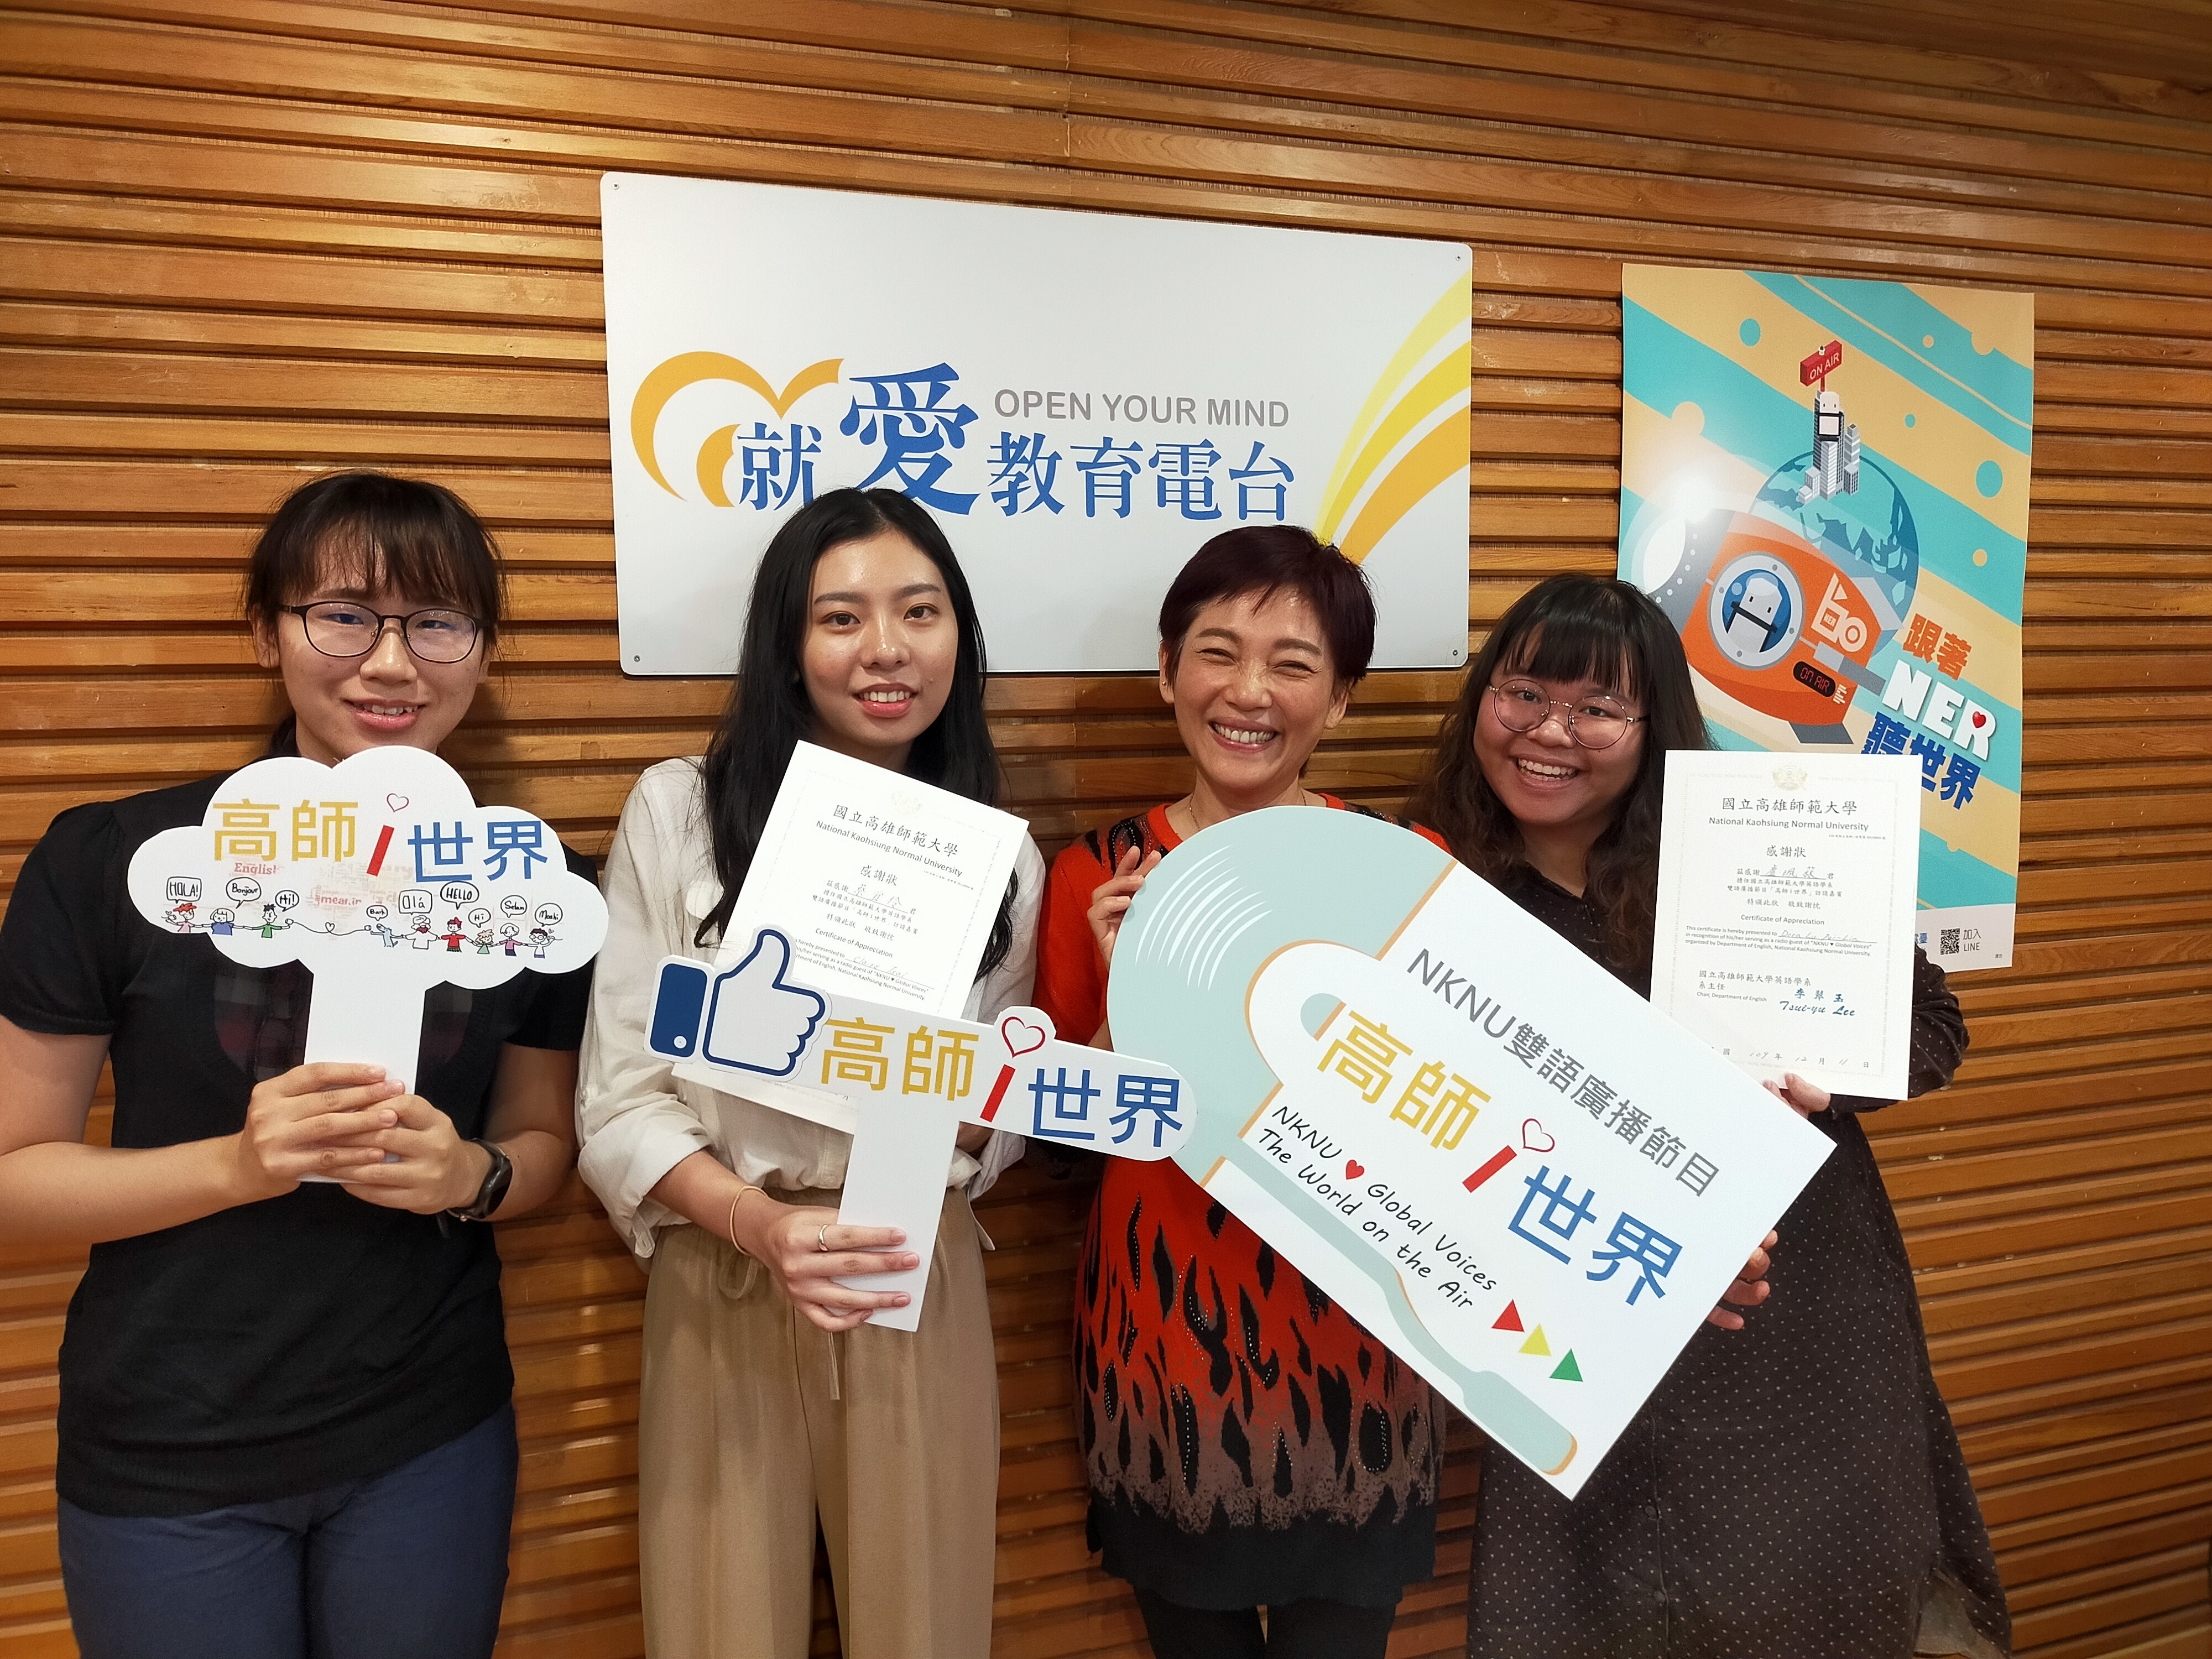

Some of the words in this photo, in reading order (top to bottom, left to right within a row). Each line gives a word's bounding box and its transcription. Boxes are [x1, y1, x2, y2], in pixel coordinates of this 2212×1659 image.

[1809, 358, 1823, 381] ON
[1825, 351, 1840, 371] AIR
[994, 388, 1091, 422] OPEN
[1103, 393, 1198, 425] YOUR
[1208, 398, 1290, 428] MIND
[738, 362, 1296, 521] 就愛教育電台
[1902, 613, 1973, 681] 跟著
[1814, 676, 1830, 693] AIR
[1881, 659, 1997, 761] NER
[1722, 797, 1858, 816] 國立高雄師範大學
[833, 805, 958, 857] 國立高雄師範大學
[1709, 817, 1744, 826] National
[1746, 818, 1790, 829] Kaohsiung
[1791, 820, 1823, 829] Normal
[1825, 821, 1869, 832] University
[816, 820, 851, 837] National
[851, 831, 891, 853] Kaohsiung
[892, 846, 922, 862] Normal
[924, 857, 963, 878] University
[1766, 844, 1807, 858] 感謝狀
[860, 865, 898, 886] 感謝狀
[169, 881, 199, 898] HOLA!
[231, 883, 259, 896] Bonjour
[446, 887, 473, 901] HELLO
[279, 894, 295, 906] Hi!
[1741, 914, 1773, 922] Certificate
[1783, 917, 1825, 926] Appreciation
[815, 928, 846, 942] Certificate
[854, 941, 894, 958] Appreciation
[1963, 928, 1981, 941] 加入
[798, 938, 815, 949] hereby
[815, 945, 839, 957] presented
[1963, 942, 1981, 952] LINE
[812, 952, 830, 962] serving
[840, 960, 853, 968] radio
[853, 965, 867, 973] guest
[895, 979, 912, 988] Global
[837, 967, 858, 978] National
[858, 974, 883, 987] Kaohsiung
[883, 982, 901, 992] Normal
[1699, 970, 1811, 987] 國立高雄師範大學英語學系
[1699, 980, 1725, 990] 系主任
[1712, 992, 1741, 1000] Department
[1780, 1000, 1826, 1015] Tsui-yu
[1832, 1005, 1856, 1016] Lee
[1774, 1052, 1782, 1061] 年
[1818, 1057, 1825, 1065] 月
[1406, 948, 1719, 1197] NKNU雙語廣播節目
[1271, 1105, 1344, 1160] NKNU
[1367, 1182, 1433, 1237] Global
[1434, 1234, 1498, 1292] Voices
[1259, 1128, 1293, 1165] The
[1298, 1164, 1363, 1217] World
[1363, 1218, 1390, 1243] on
[1396, 1245, 1432, 1279] the
[1437, 1280, 1474, 1311] Air
